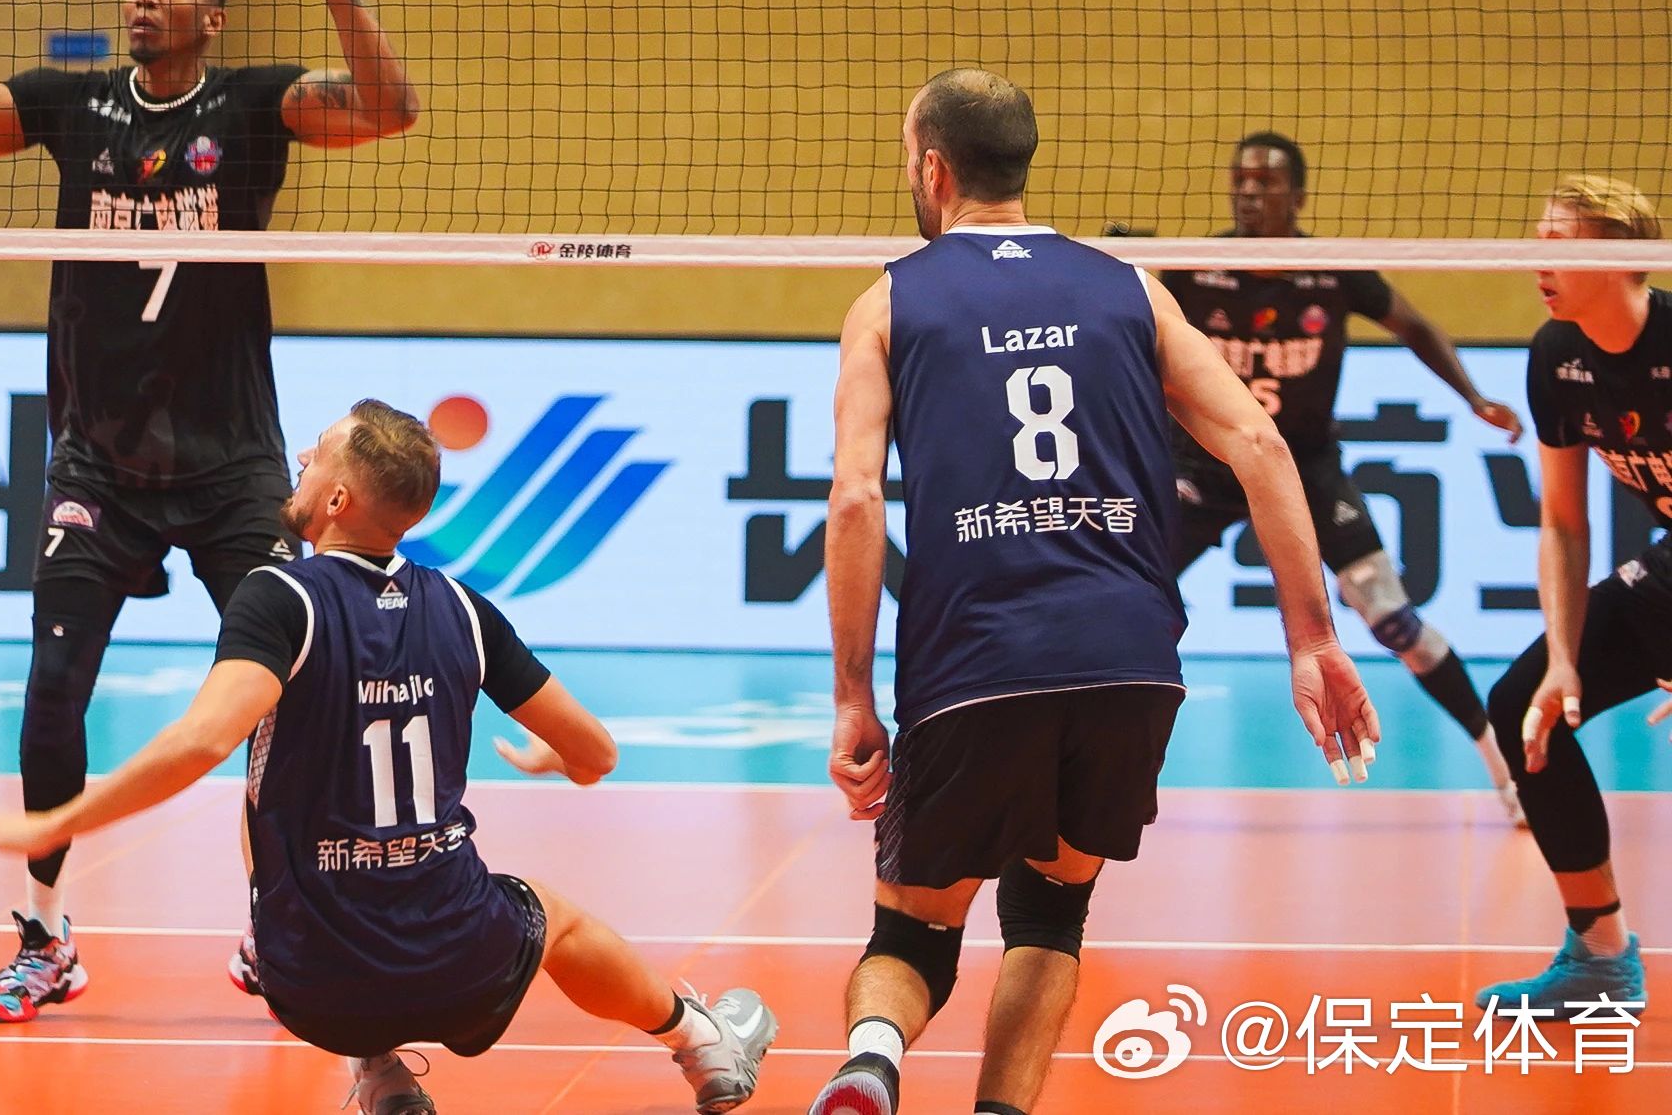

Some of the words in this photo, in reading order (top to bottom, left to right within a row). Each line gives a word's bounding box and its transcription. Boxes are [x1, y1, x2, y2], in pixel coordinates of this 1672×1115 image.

[559, 243, 632, 258] 金陵体育
[992, 248, 1032, 261] PEAK
[139, 261, 178, 322] 7
[981, 324, 1079, 355] Lazar
[1005, 364, 1080, 481] 8
[954, 497, 1138, 543] 新希望天香
[45, 528, 65, 557] 7
[375, 596, 409, 610] PEAK
[358, 675, 434, 706] Mihajlo
[362, 714, 437, 828] 11
